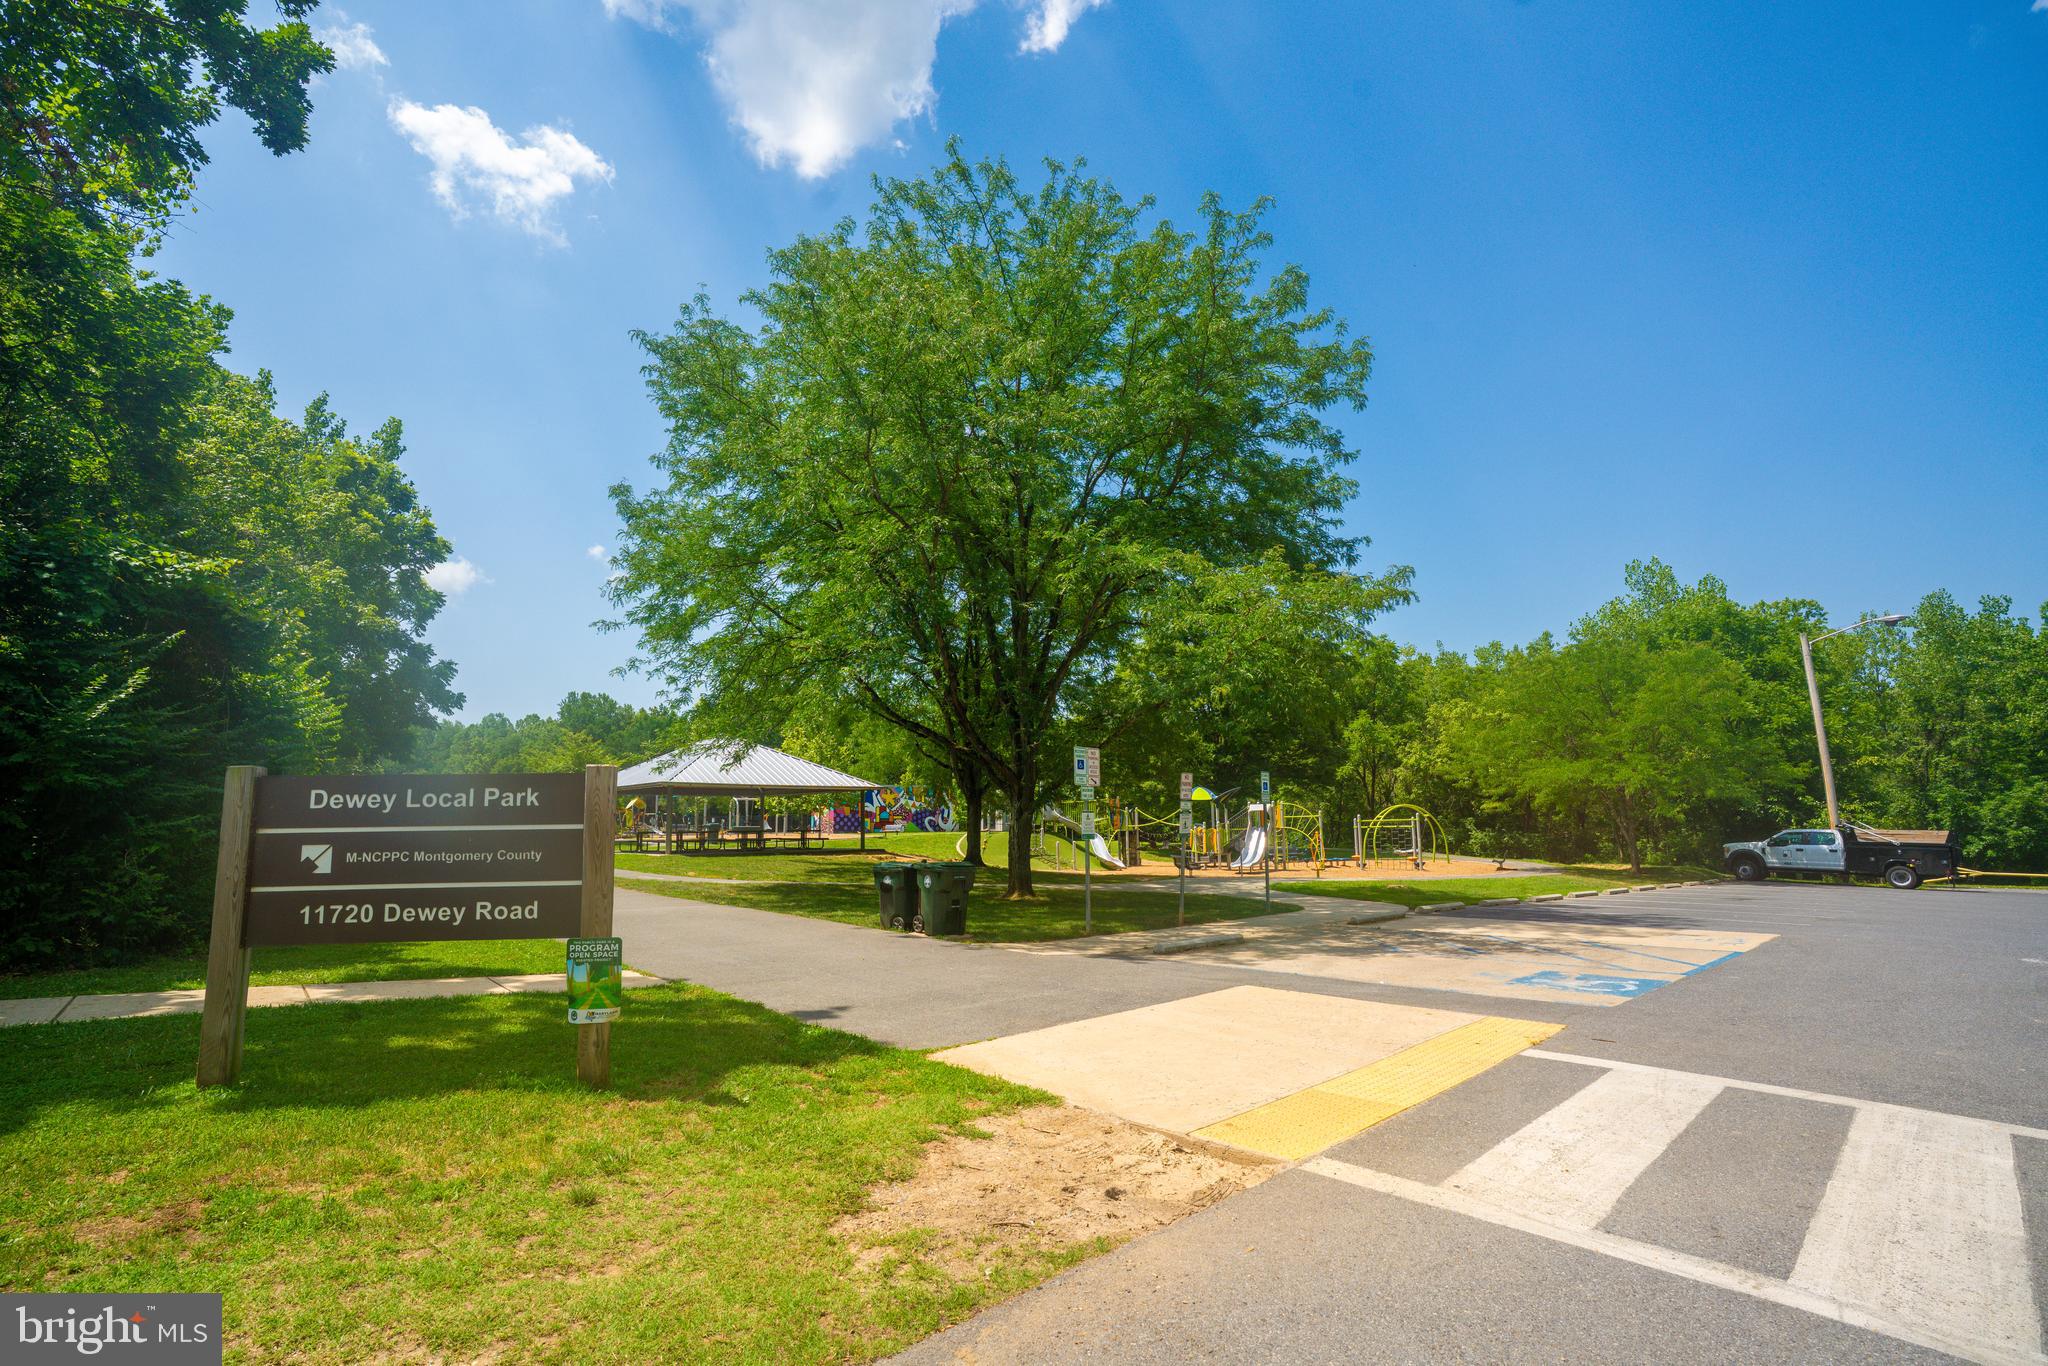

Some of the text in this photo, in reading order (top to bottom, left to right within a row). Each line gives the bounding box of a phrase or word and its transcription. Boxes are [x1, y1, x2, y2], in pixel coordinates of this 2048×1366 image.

[309, 787, 540, 814] Dewey Local Park
[346, 849, 542, 864] M-NCPPC Montgomery County
[300, 901, 538, 926] 11720 Dewey Road
[570, 944, 619, 952] PROGRAM
